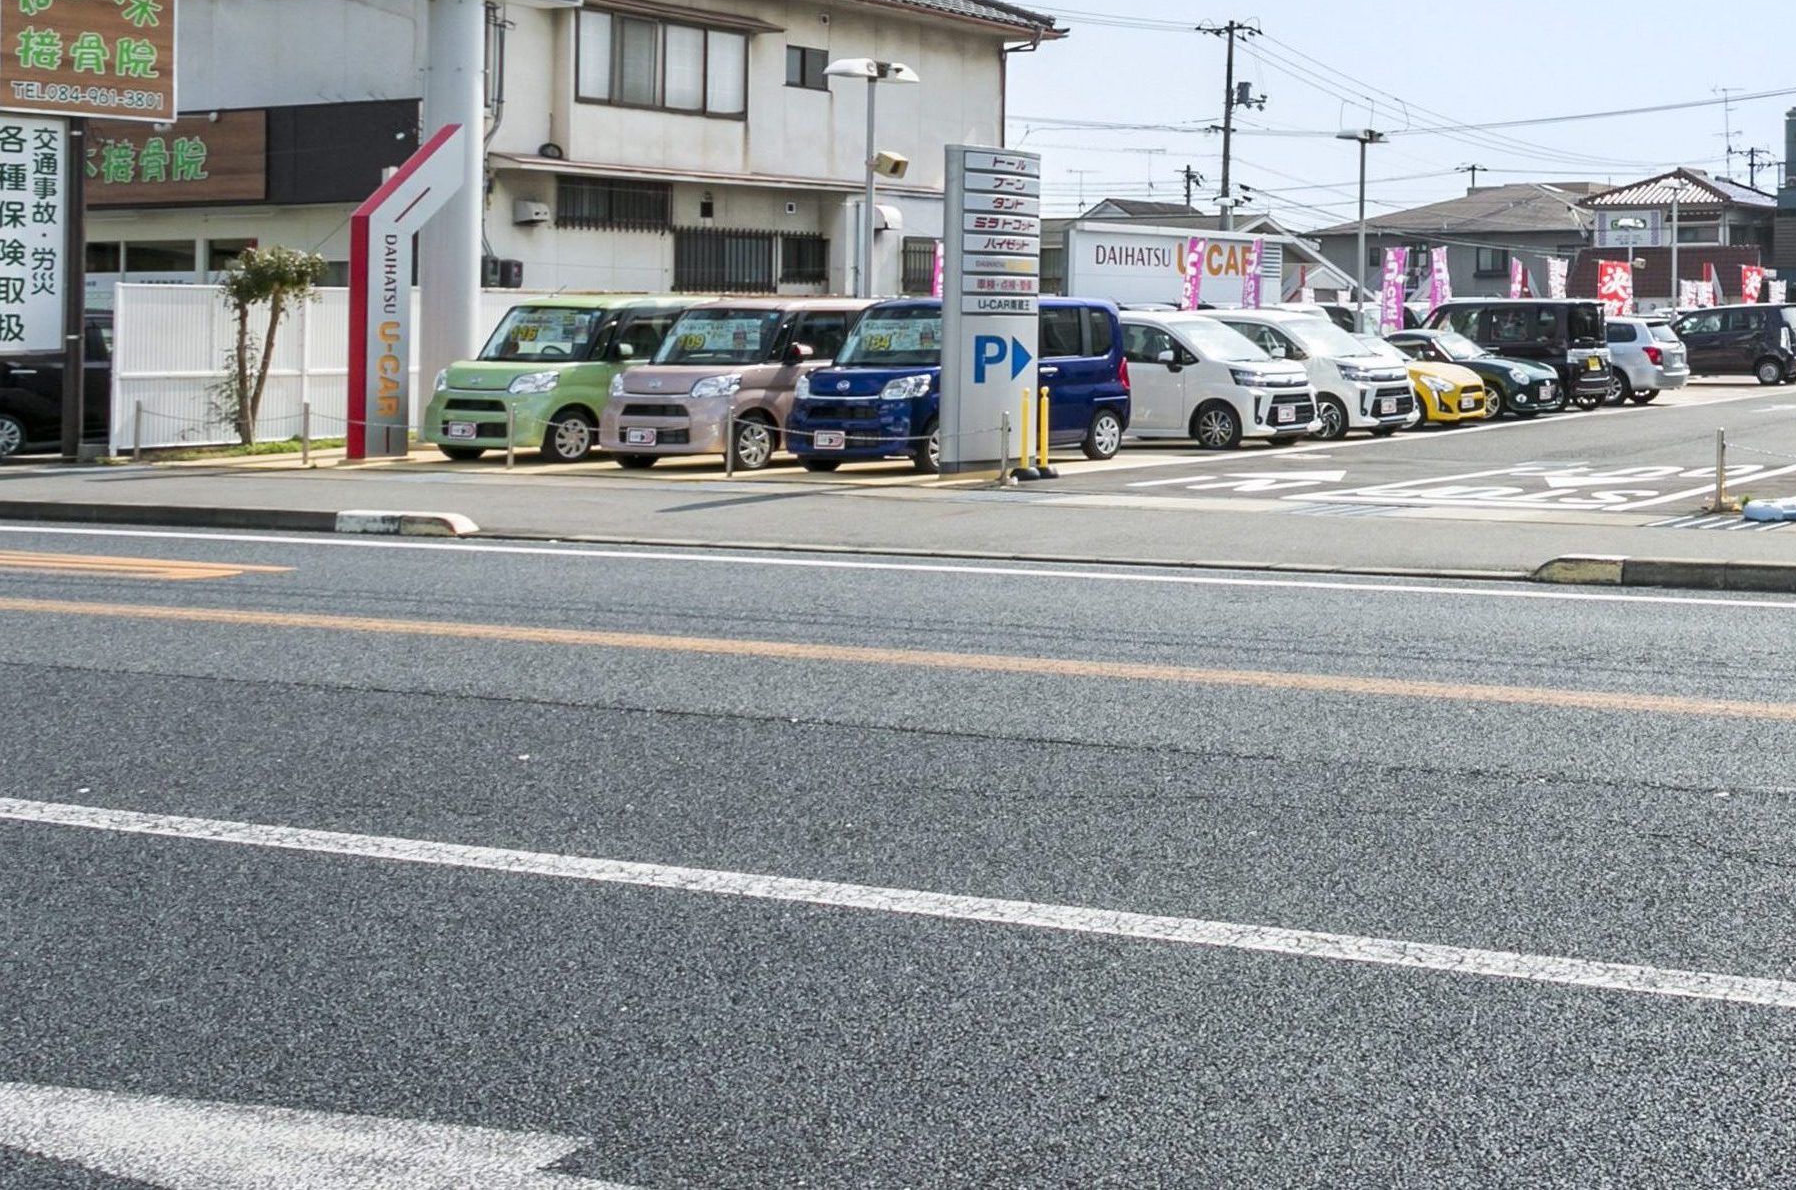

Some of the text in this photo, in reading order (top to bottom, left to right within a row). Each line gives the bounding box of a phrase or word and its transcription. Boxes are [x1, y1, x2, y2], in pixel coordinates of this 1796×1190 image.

[16, 26, 160, 78] 接骨院
[992, 156, 1026, 171] トール
[31, 127, 58, 296] 交通事故・労災
[992, 197, 1024, 210] タント
[984, 238, 1030, 251] ハイゼット
[1095, 245, 1171, 267] DAIHATSU
[376, 234, 400, 417] DAIHATSU U-CAR
[974, 335, 1008, 383] P
